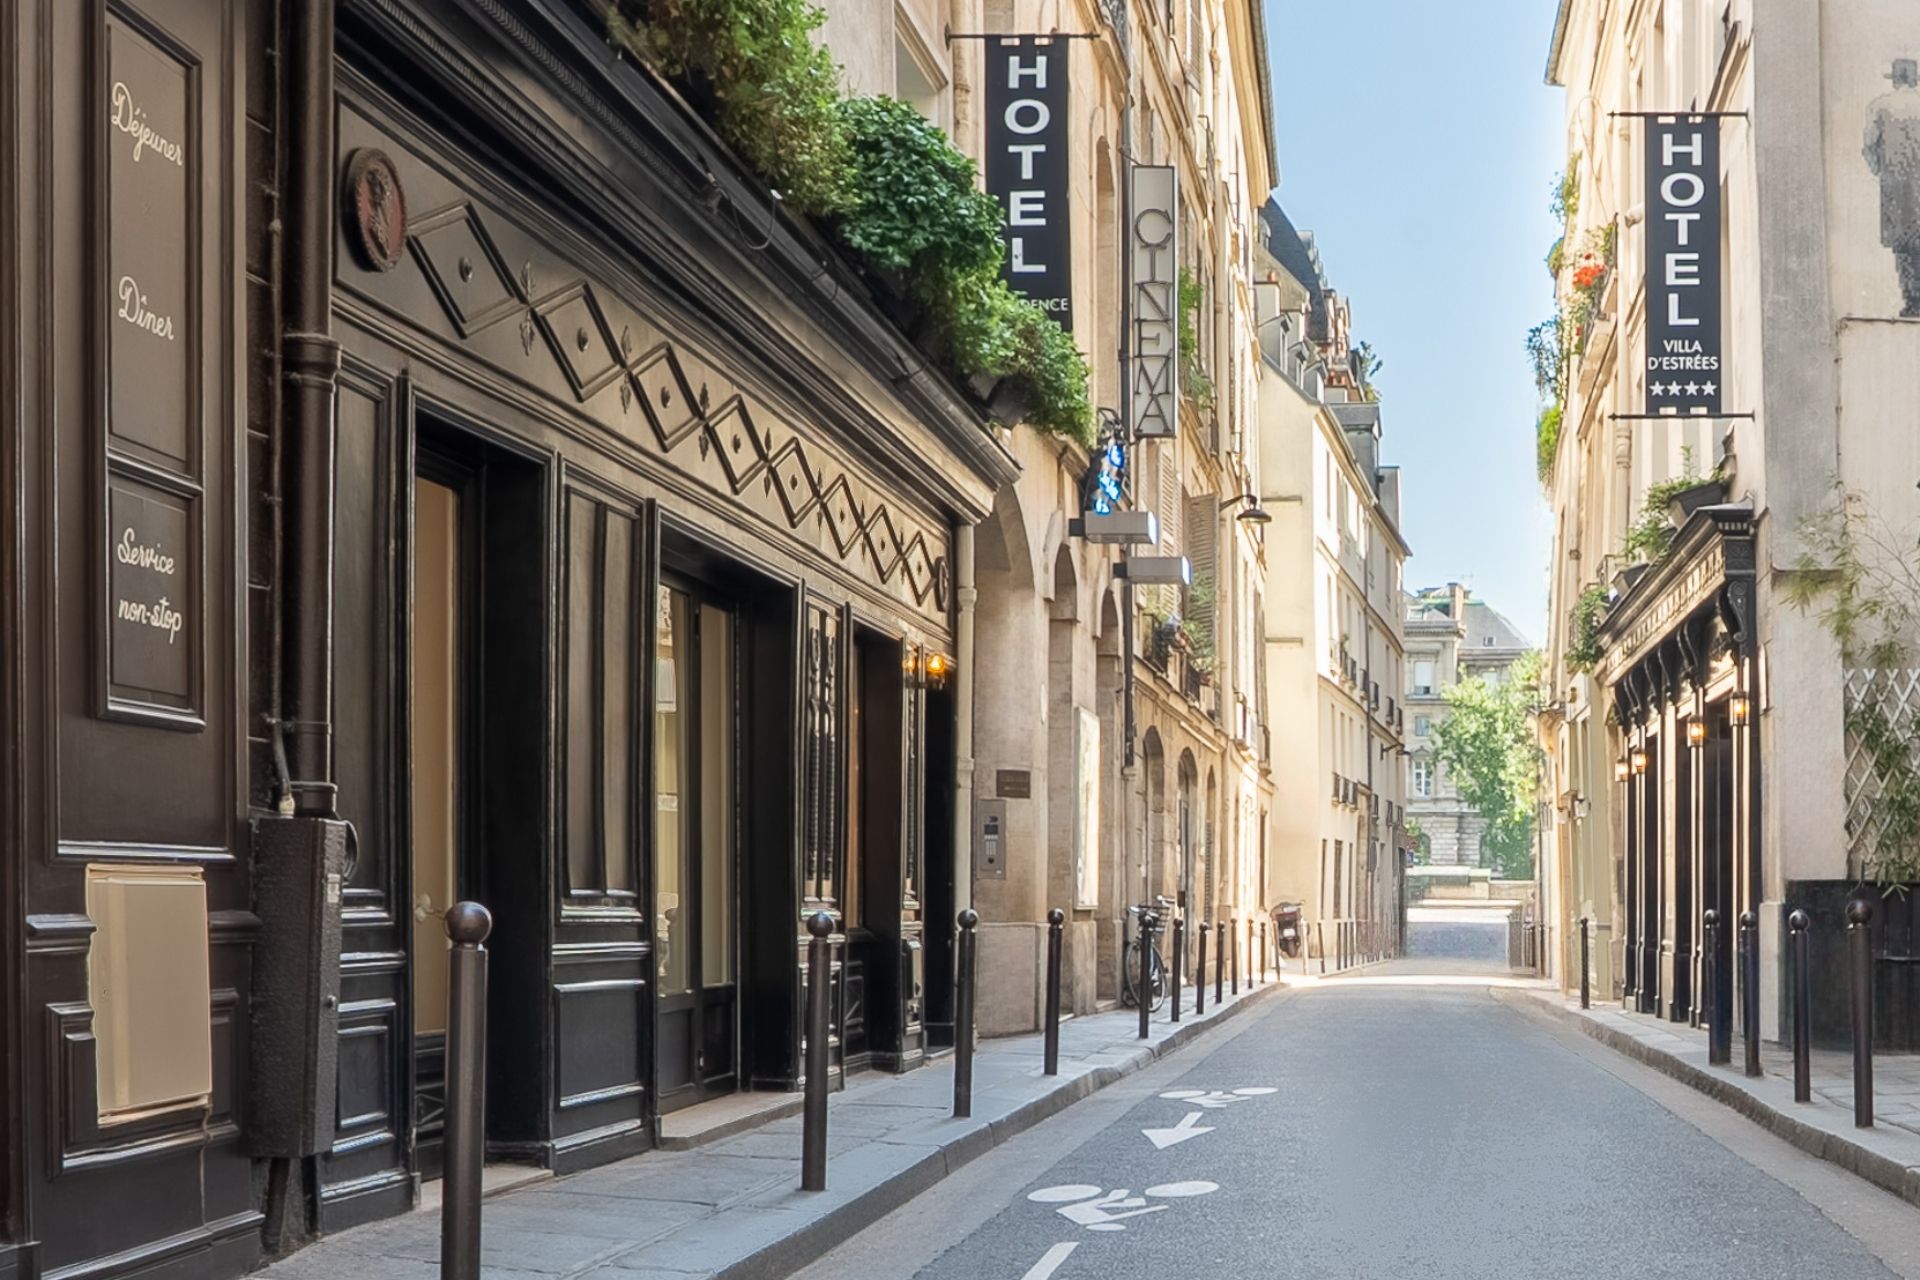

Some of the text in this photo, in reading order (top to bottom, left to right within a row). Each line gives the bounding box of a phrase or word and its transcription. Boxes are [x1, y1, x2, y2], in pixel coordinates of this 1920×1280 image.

[111, 82, 183, 166] Déjeuner
[1004, 55, 1050, 273] HOTEL
[1661, 133, 1705, 326] HOTEL
[118, 275, 175, 340] Dîner
[1134, 207, 1173, 434] CINEMA
[1647, 353, 1719, 371] D'ESTRÉES
[1663, 339, 1703, 353] VILLA
[117, 527, 176, 575] Service
[118, 596, 182, 644] non-stop
